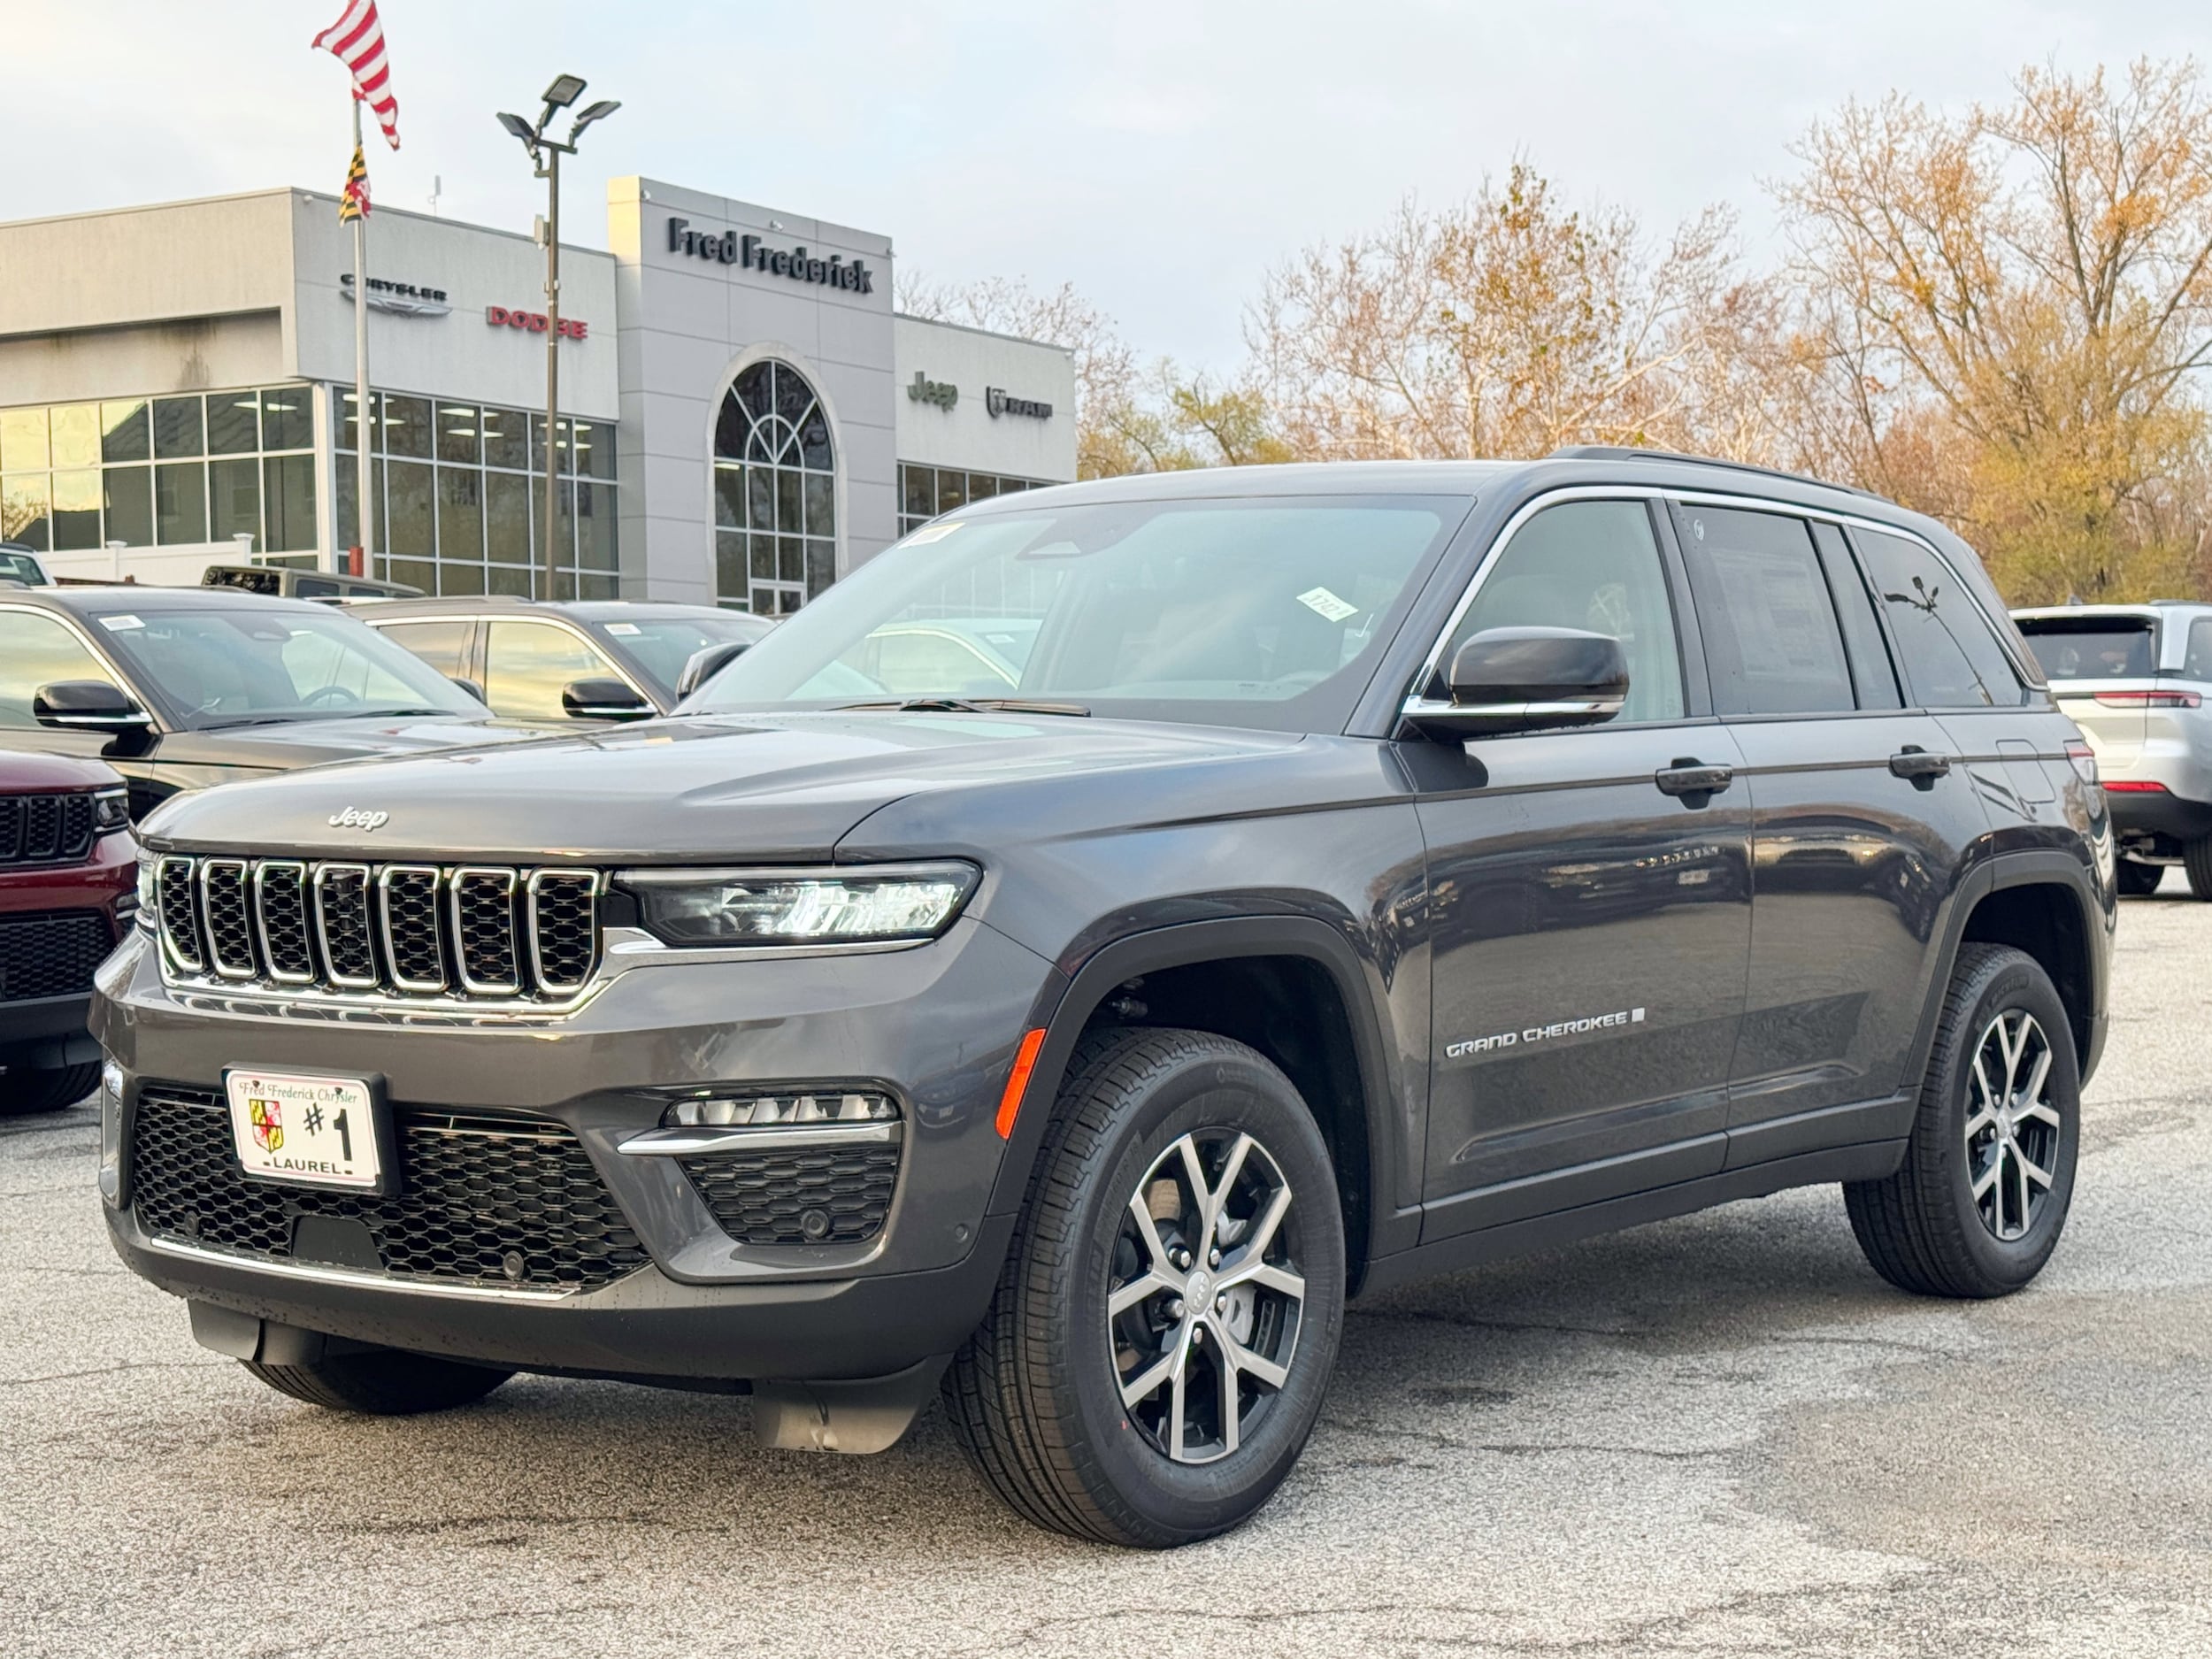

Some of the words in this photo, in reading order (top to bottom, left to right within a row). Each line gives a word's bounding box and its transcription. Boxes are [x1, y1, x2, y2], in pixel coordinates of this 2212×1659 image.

[668, 217, 737, 265] Fred
[741, 234, 873, 294] Frederick
[340, 273, 447, 301] CRYSLER
[907, 371, 958, 412] Jeep
[1005, 397, 1053, 419] RAM
[328, 806, 389, 833] Jeep
[1446, 1033, 1517, 1058] GRAND
[1522, 1011, 1628, 1043] CHEROKEE
[240, 1081, 265, 1096] Fred
[268, 1084, 315, 1100] Frederick
[318, 1087, 357, 1104] Chrysler
[273, 1157, 342, 1175] LAUREL
